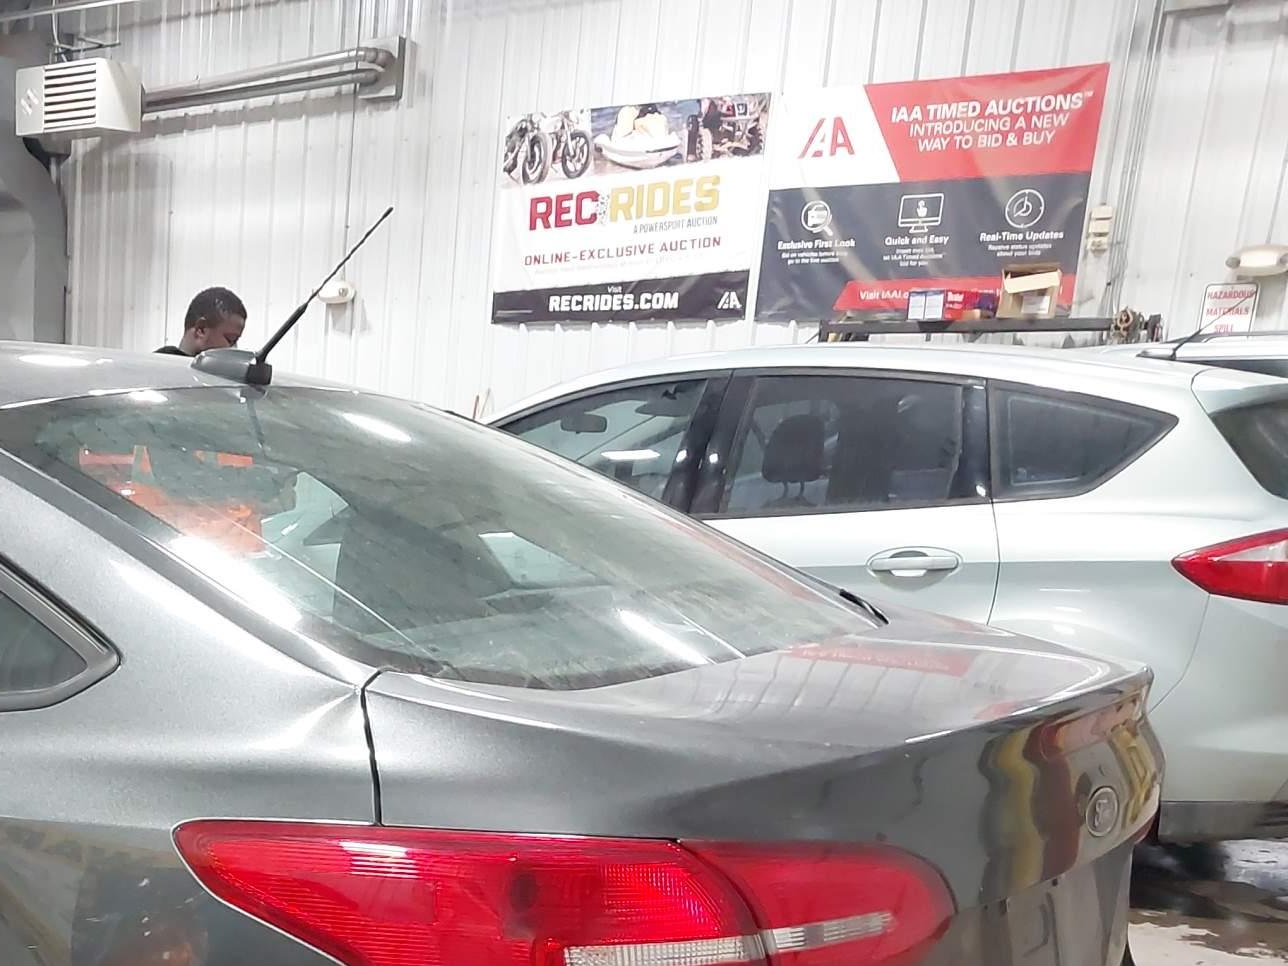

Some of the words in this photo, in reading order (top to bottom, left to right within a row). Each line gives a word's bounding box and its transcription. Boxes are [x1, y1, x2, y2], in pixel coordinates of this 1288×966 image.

[891, 105, 923, 123] IAA
[926, 101, 981, 120] TIMED
[909, 117, 1011, 137] INTRODUCING
[1014, 115, 1026, 130] A
[1031, 112, 1070, 129] NEW
[918, 136, 951, 152] WAY
[954, 134, 973, 149] TO
[977, 132, 1003, 148] BID
[1005, 132, 1018, 146] &
[1022, 129, 1055, 146] BUY
[529, 191, 601, 231] REC
[608, 175, 721, 222] RIDES
[639, 219, 684, 233] POWERSPORT
[686, 216, 718, 228] AUCTION
[777, 241, 813, 250] Exclusive
[814, 240, 833, 249] First
[835, 239, 856, 248] Look
[885, 236, 910, 246] Quick
[911, 236, 928, 244] and
[929, 234, 949, 245] Easy
[979, 231, 1023, 242] Real-Time
[1026, 231, 1064, 242] Updates
[524, 243, 655, 266] ONLINE-EXCLUSIVE
[660, 236, 721, 252] AUCTION
[607, 285, 622, 293] Visit
[859, 290, 881, 300] Visit
[548, 292, 679, 313] RECRIDES.COM
